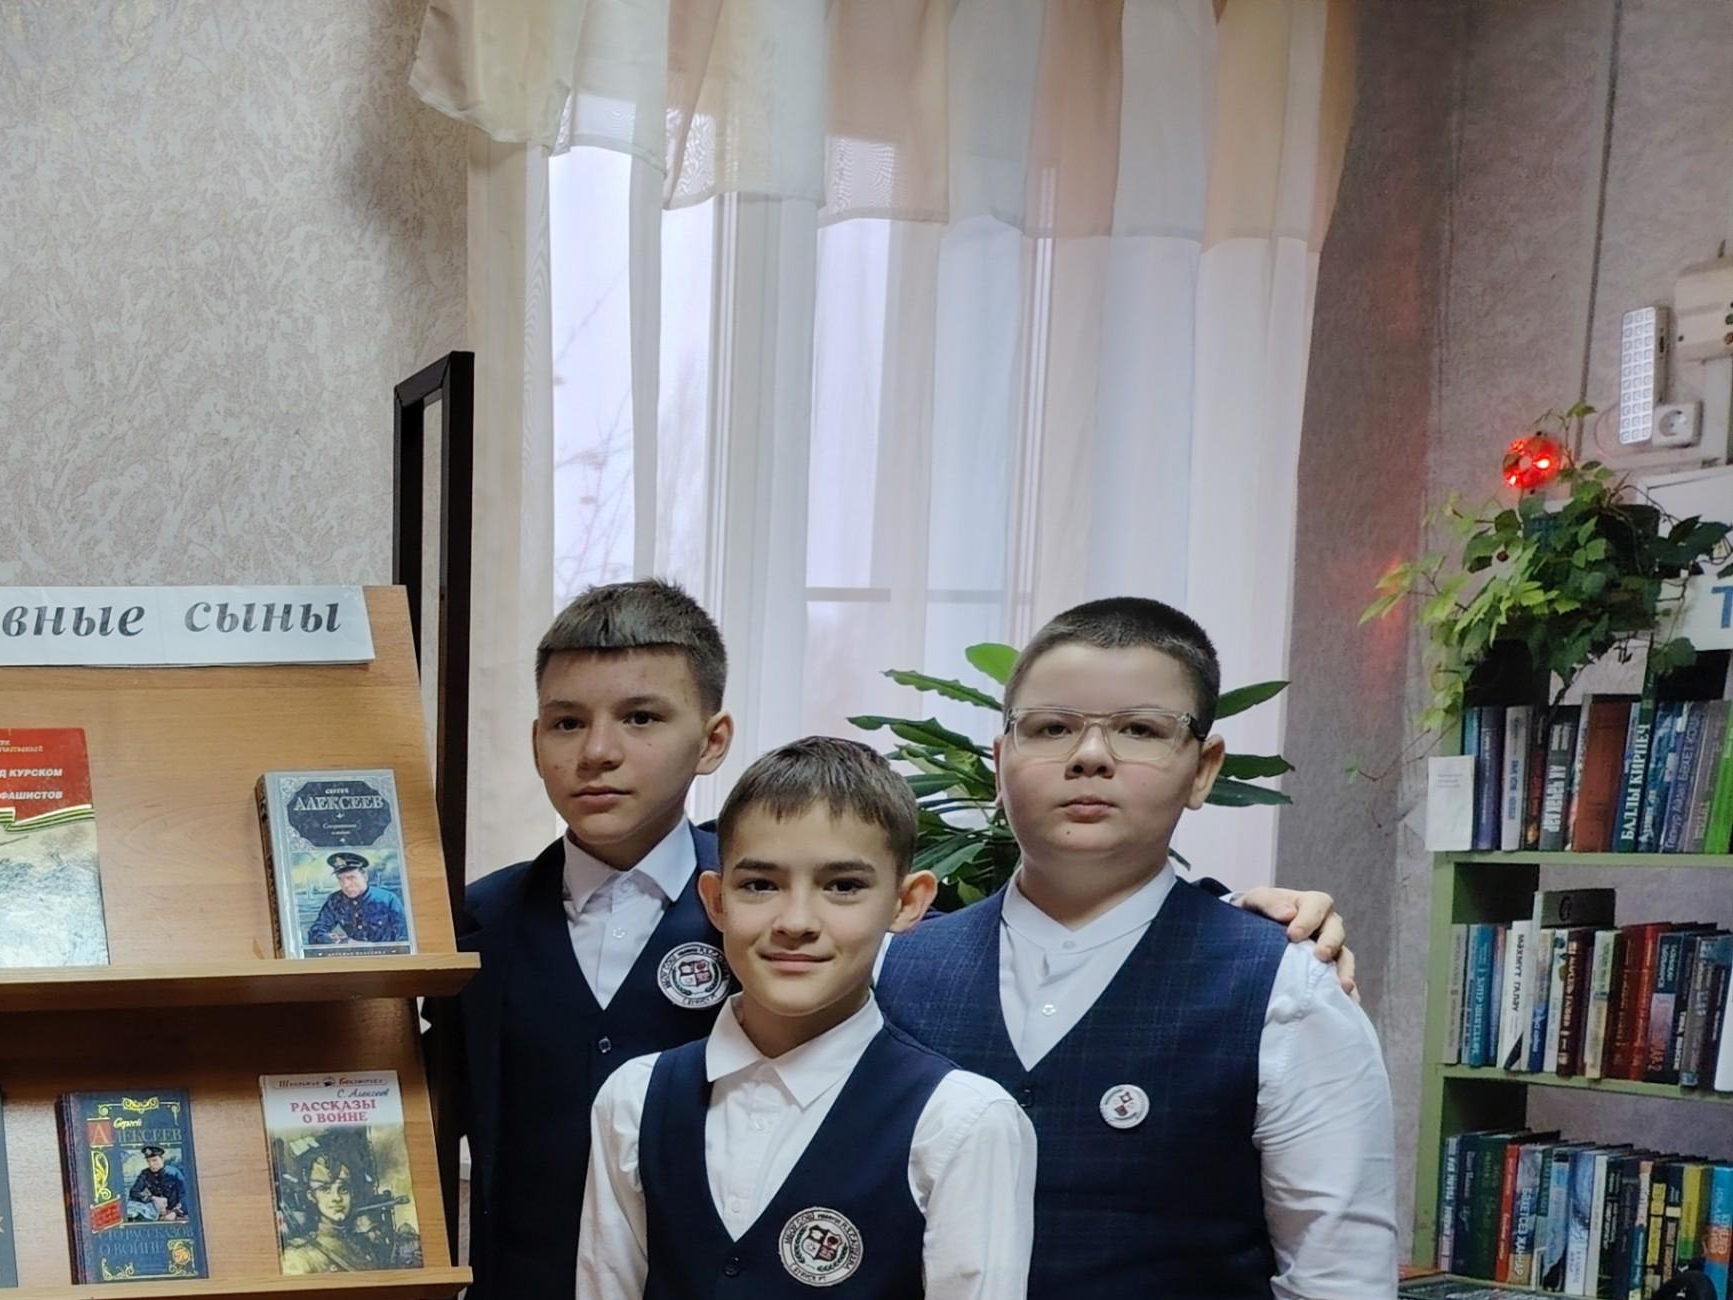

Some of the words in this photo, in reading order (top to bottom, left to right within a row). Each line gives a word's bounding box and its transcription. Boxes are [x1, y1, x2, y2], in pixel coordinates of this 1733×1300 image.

[182, 599, 343, 635] сыны
[1628, 723, 1651, 785] КИРПЕЧ
[9, 767, 64, 778] КУРСКОМ
[293, 794, 385, 812] АЛЕКСЕЕВ
[1620, 787, 1640, 841] БАЛЛЫ
[290, 1099, 377, 1113] РАССКАЗЫ
[302, 1113, 313, 1124] О
[317, 1110, 369, 1123] ВОЙНЕ
